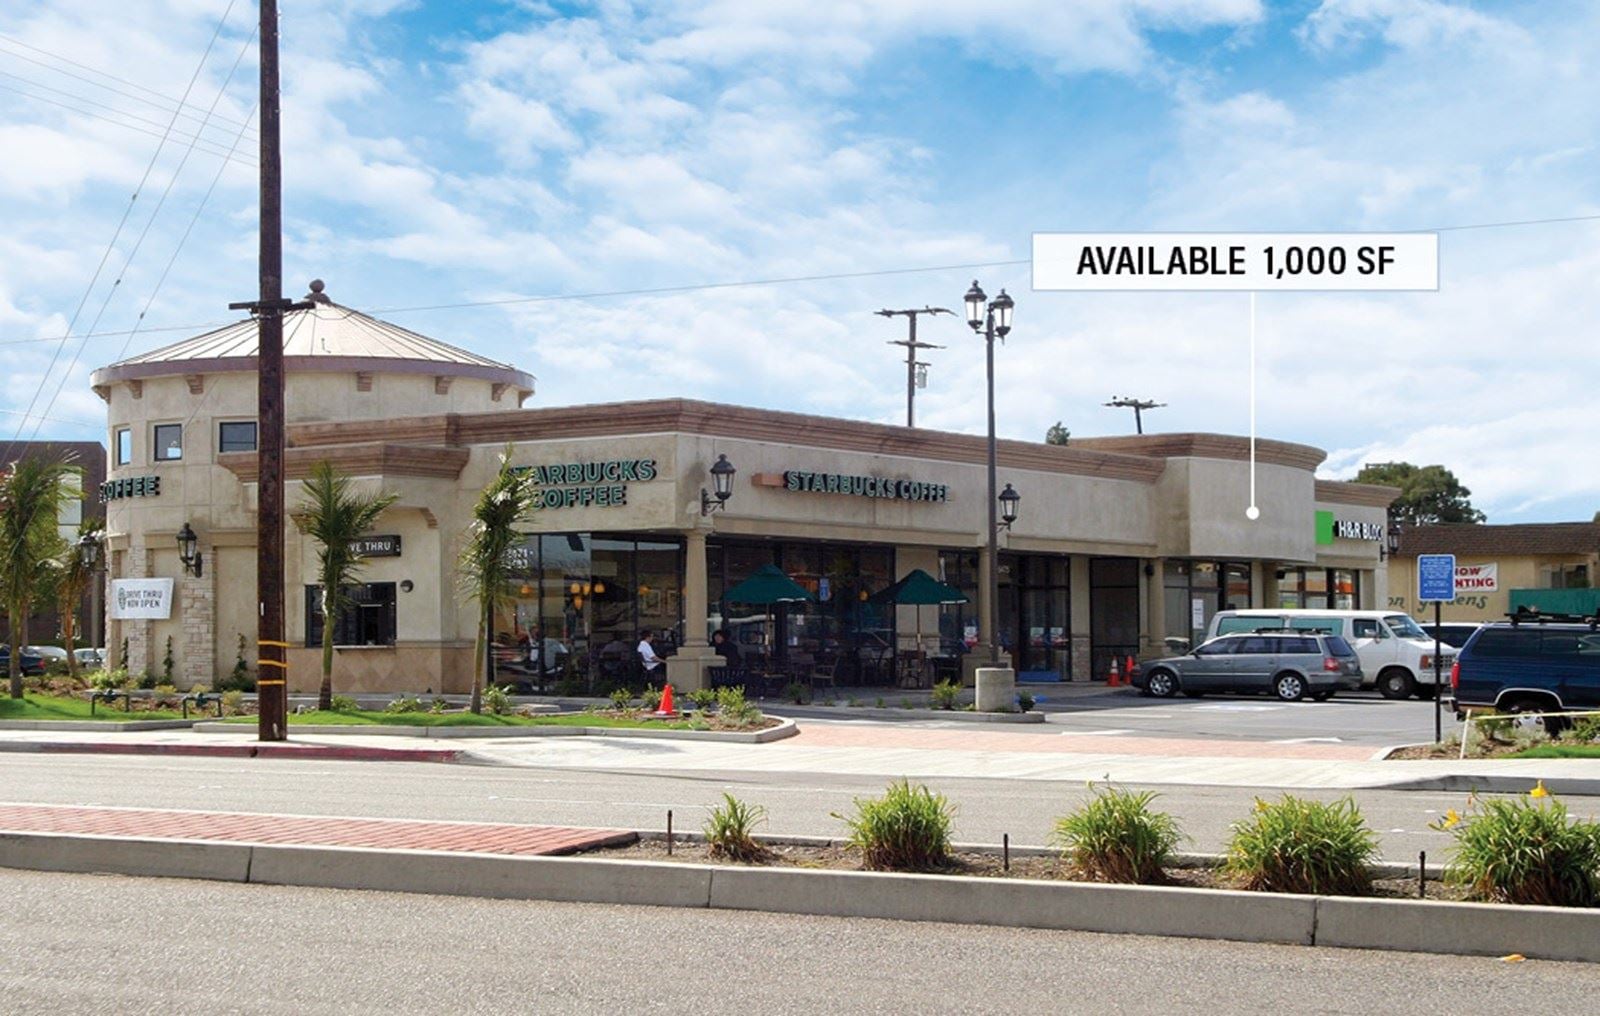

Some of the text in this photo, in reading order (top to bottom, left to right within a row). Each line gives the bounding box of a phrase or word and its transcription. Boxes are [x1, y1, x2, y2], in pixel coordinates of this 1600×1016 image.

[510, 459, 656, 485] TARBUCKS
[787, 471, 896, 498] STARBUCKS
[1362, 523, 1384, 541] BLOC
[365, 541, 391, 551] THRU
[1455, 578, 1494, 588] NTING
